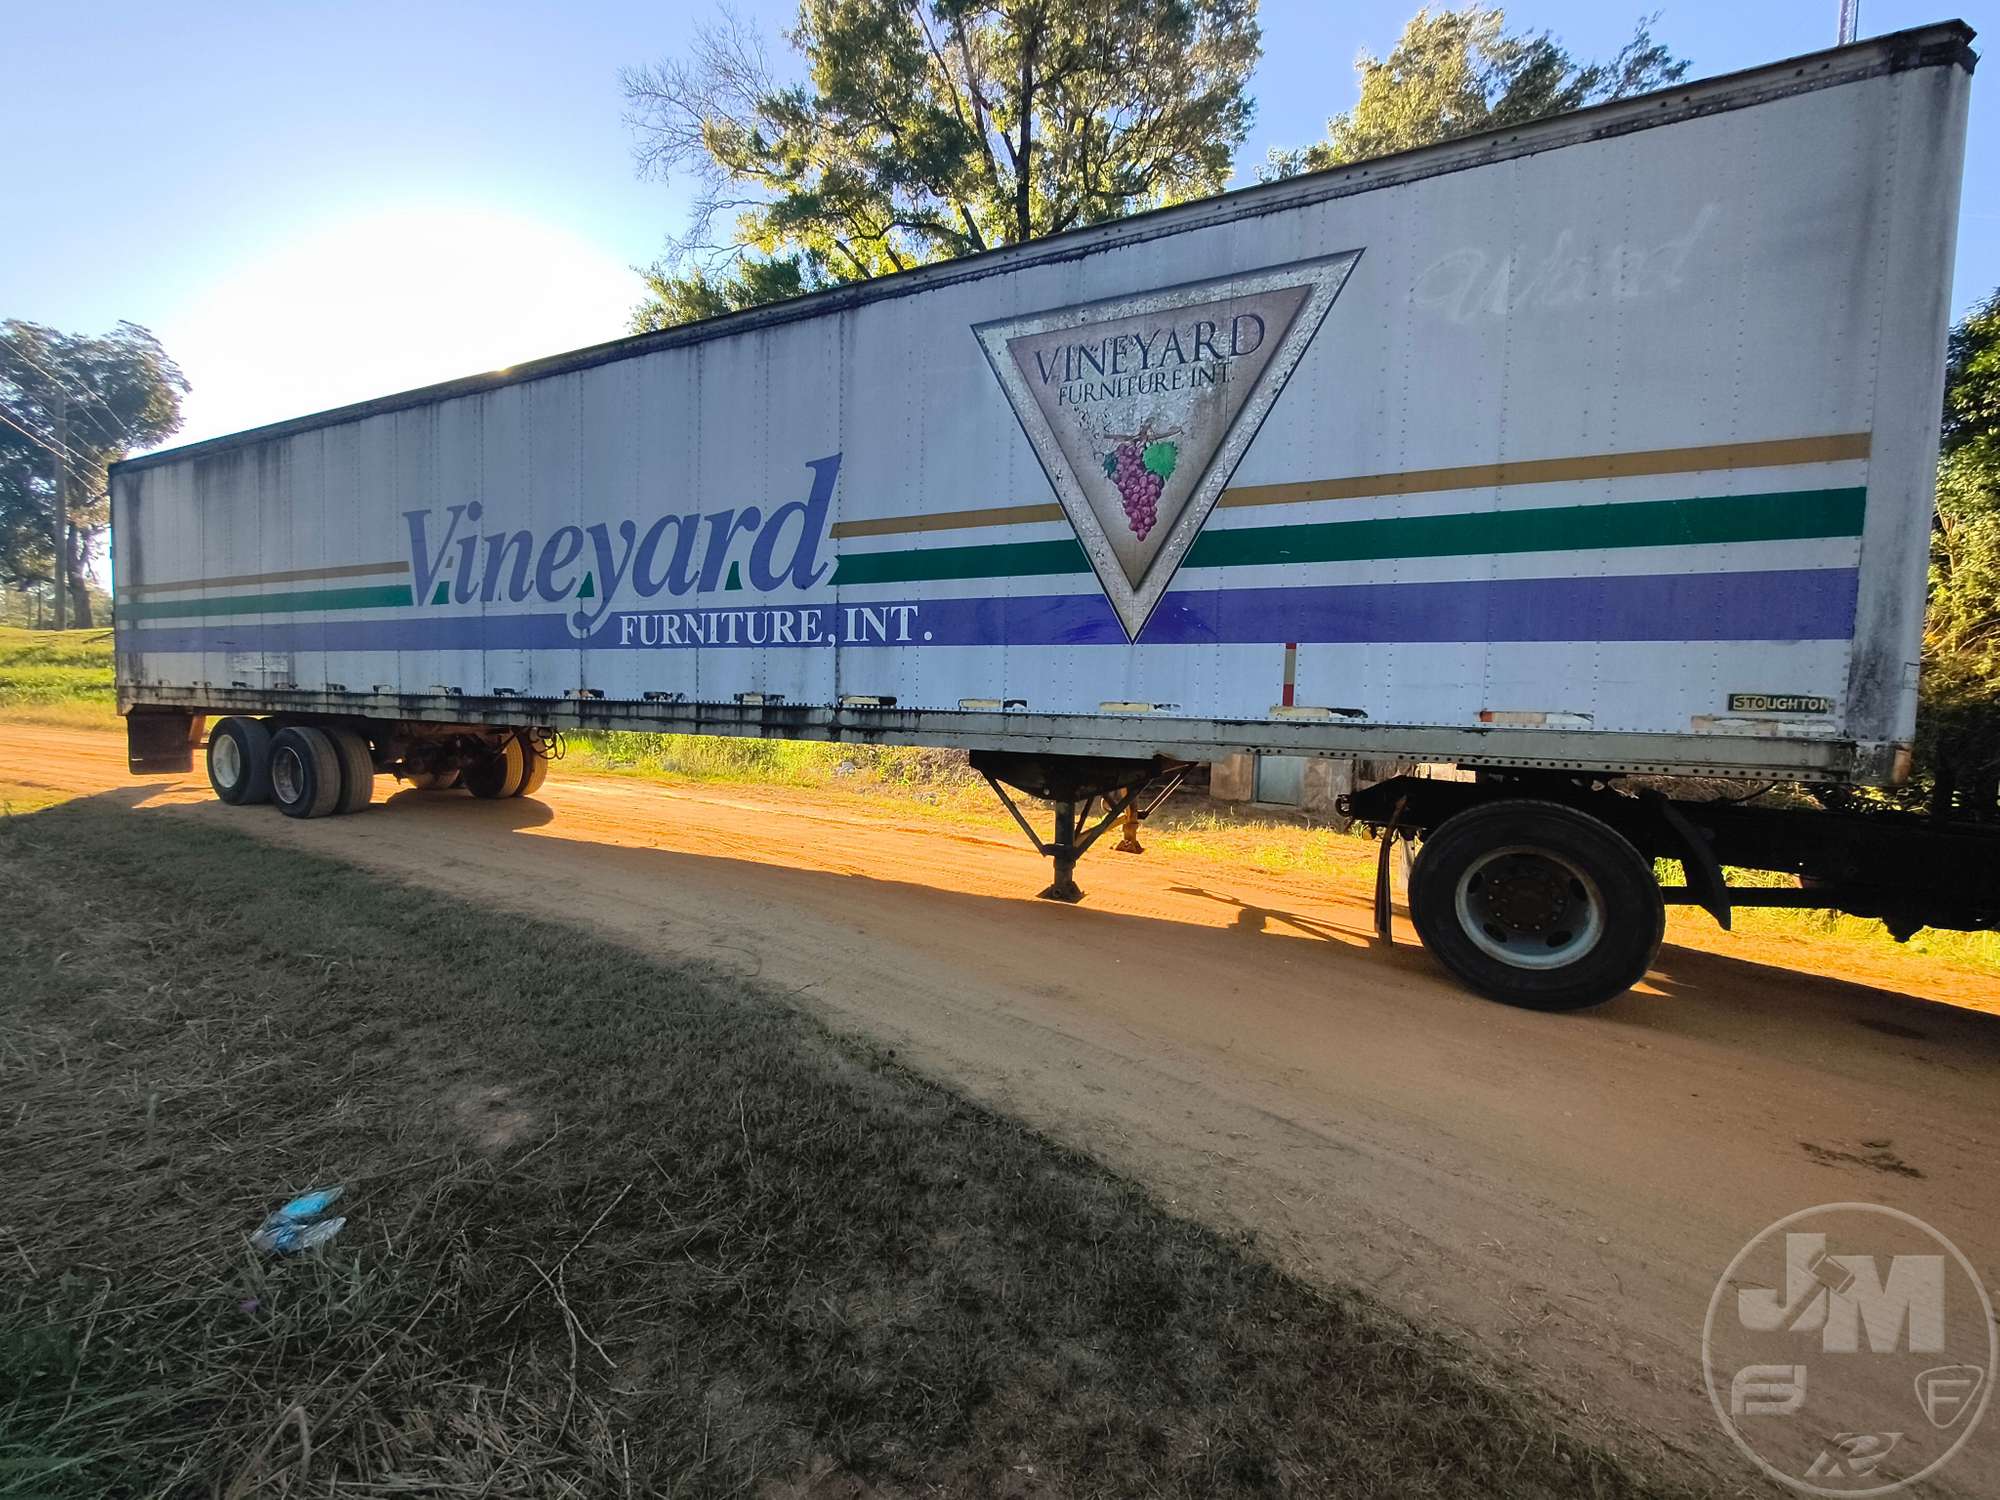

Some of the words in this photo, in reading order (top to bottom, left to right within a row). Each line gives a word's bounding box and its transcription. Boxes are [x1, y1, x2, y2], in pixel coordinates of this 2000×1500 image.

[1034, 313, 1265, 386] VINEYARD
[1058, 369, 1184, 405] FURNITURE
[1191, 361, 1235, 388] INT.
[402, 452, 842, 640] Vineyard
[619, 607, 837, 648] FURNITURE,
[843, 605, 933, 643] INT.
[1734, 695, 1829, 711] STOUGHTON
